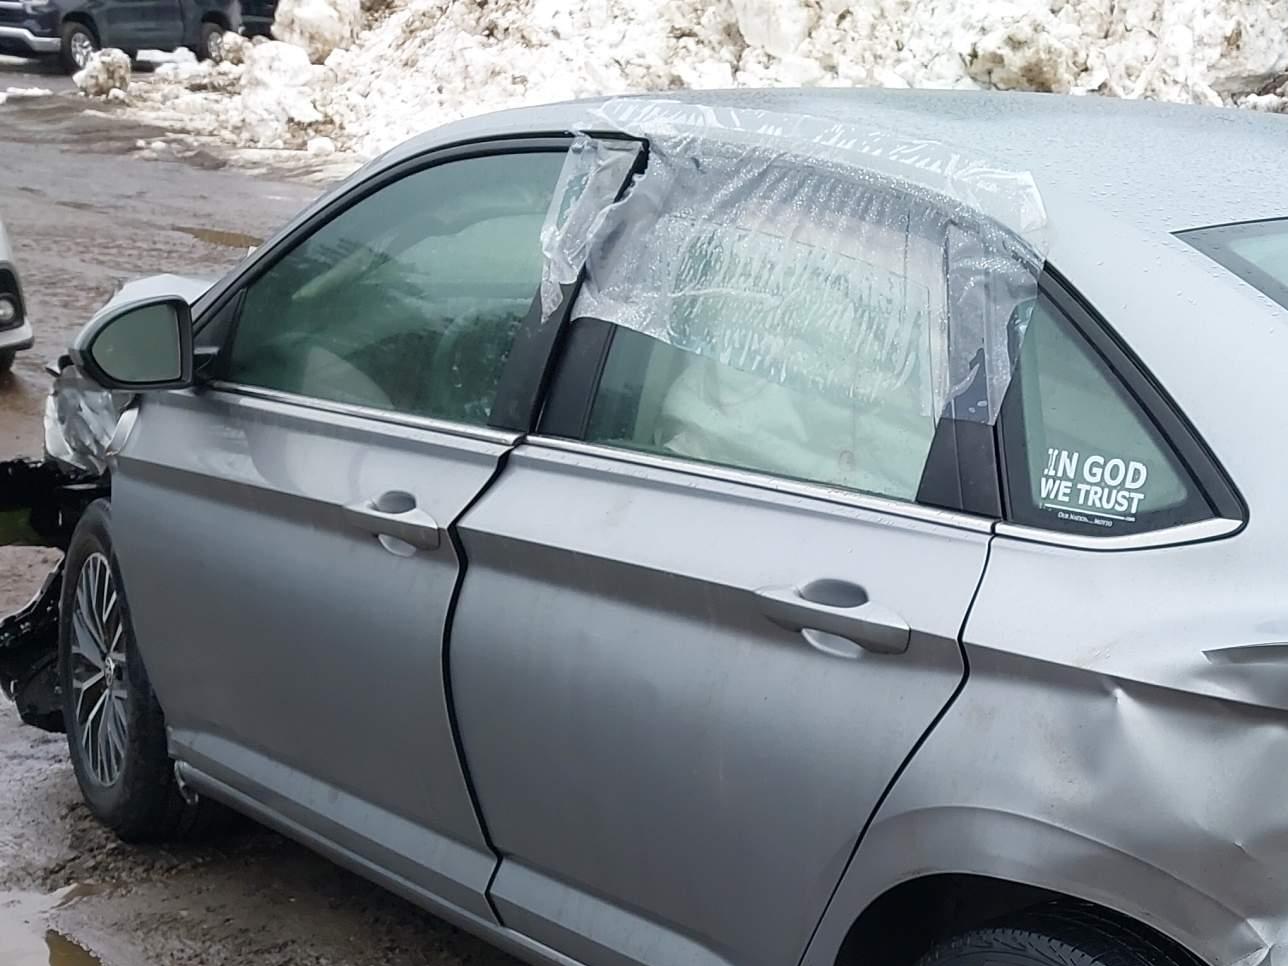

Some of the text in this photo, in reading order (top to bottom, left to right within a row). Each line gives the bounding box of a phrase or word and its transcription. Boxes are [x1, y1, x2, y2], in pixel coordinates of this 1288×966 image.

[1043, 448, 1147, 489] IN GOD
[1040, 477, 1145, 514] WE TRUST
